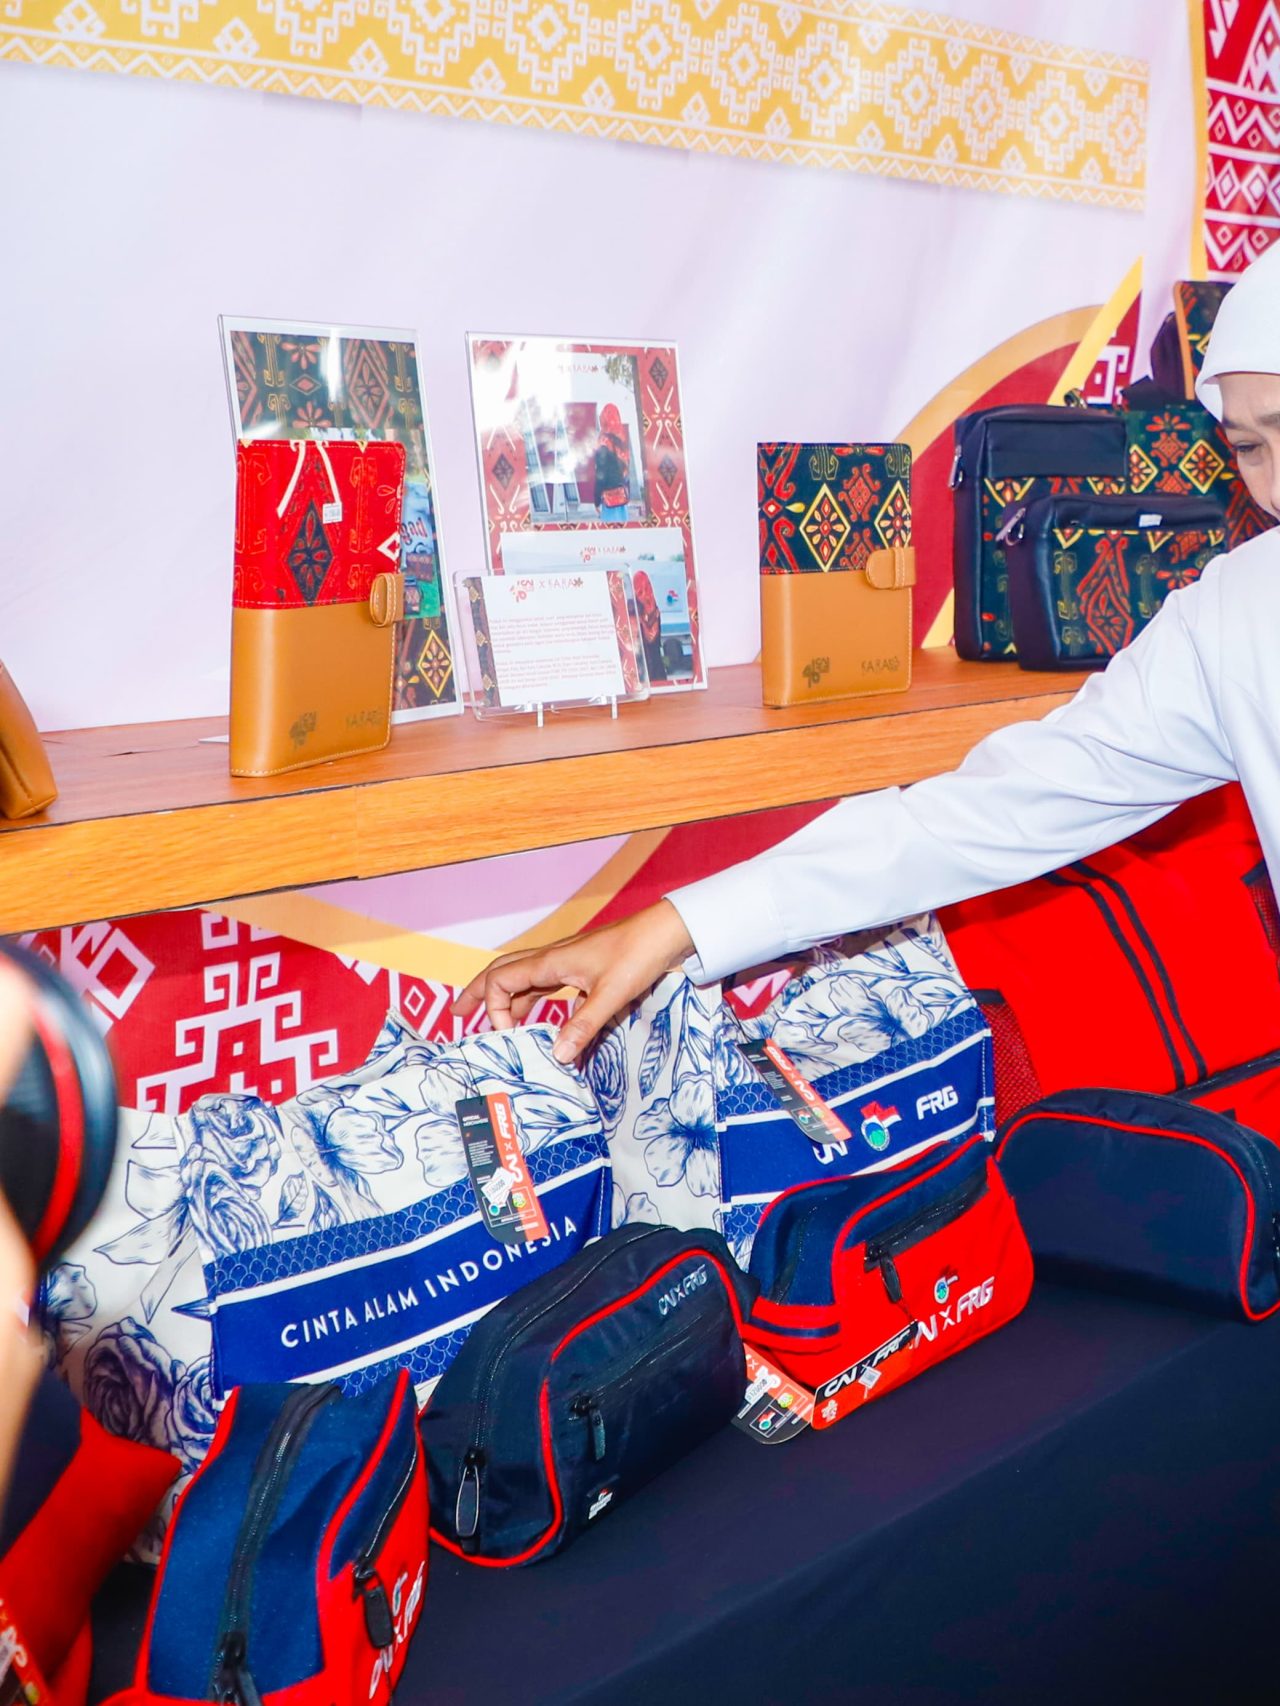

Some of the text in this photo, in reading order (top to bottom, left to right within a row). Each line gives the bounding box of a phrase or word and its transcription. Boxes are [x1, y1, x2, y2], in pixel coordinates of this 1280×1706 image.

[916, 1085, 959, 1120] FRG
[280, 1310, 358, 1347] CINTA
[364, 1287, 419, 1323] ALAM
[956, 1276, 995, 1324] FRG
